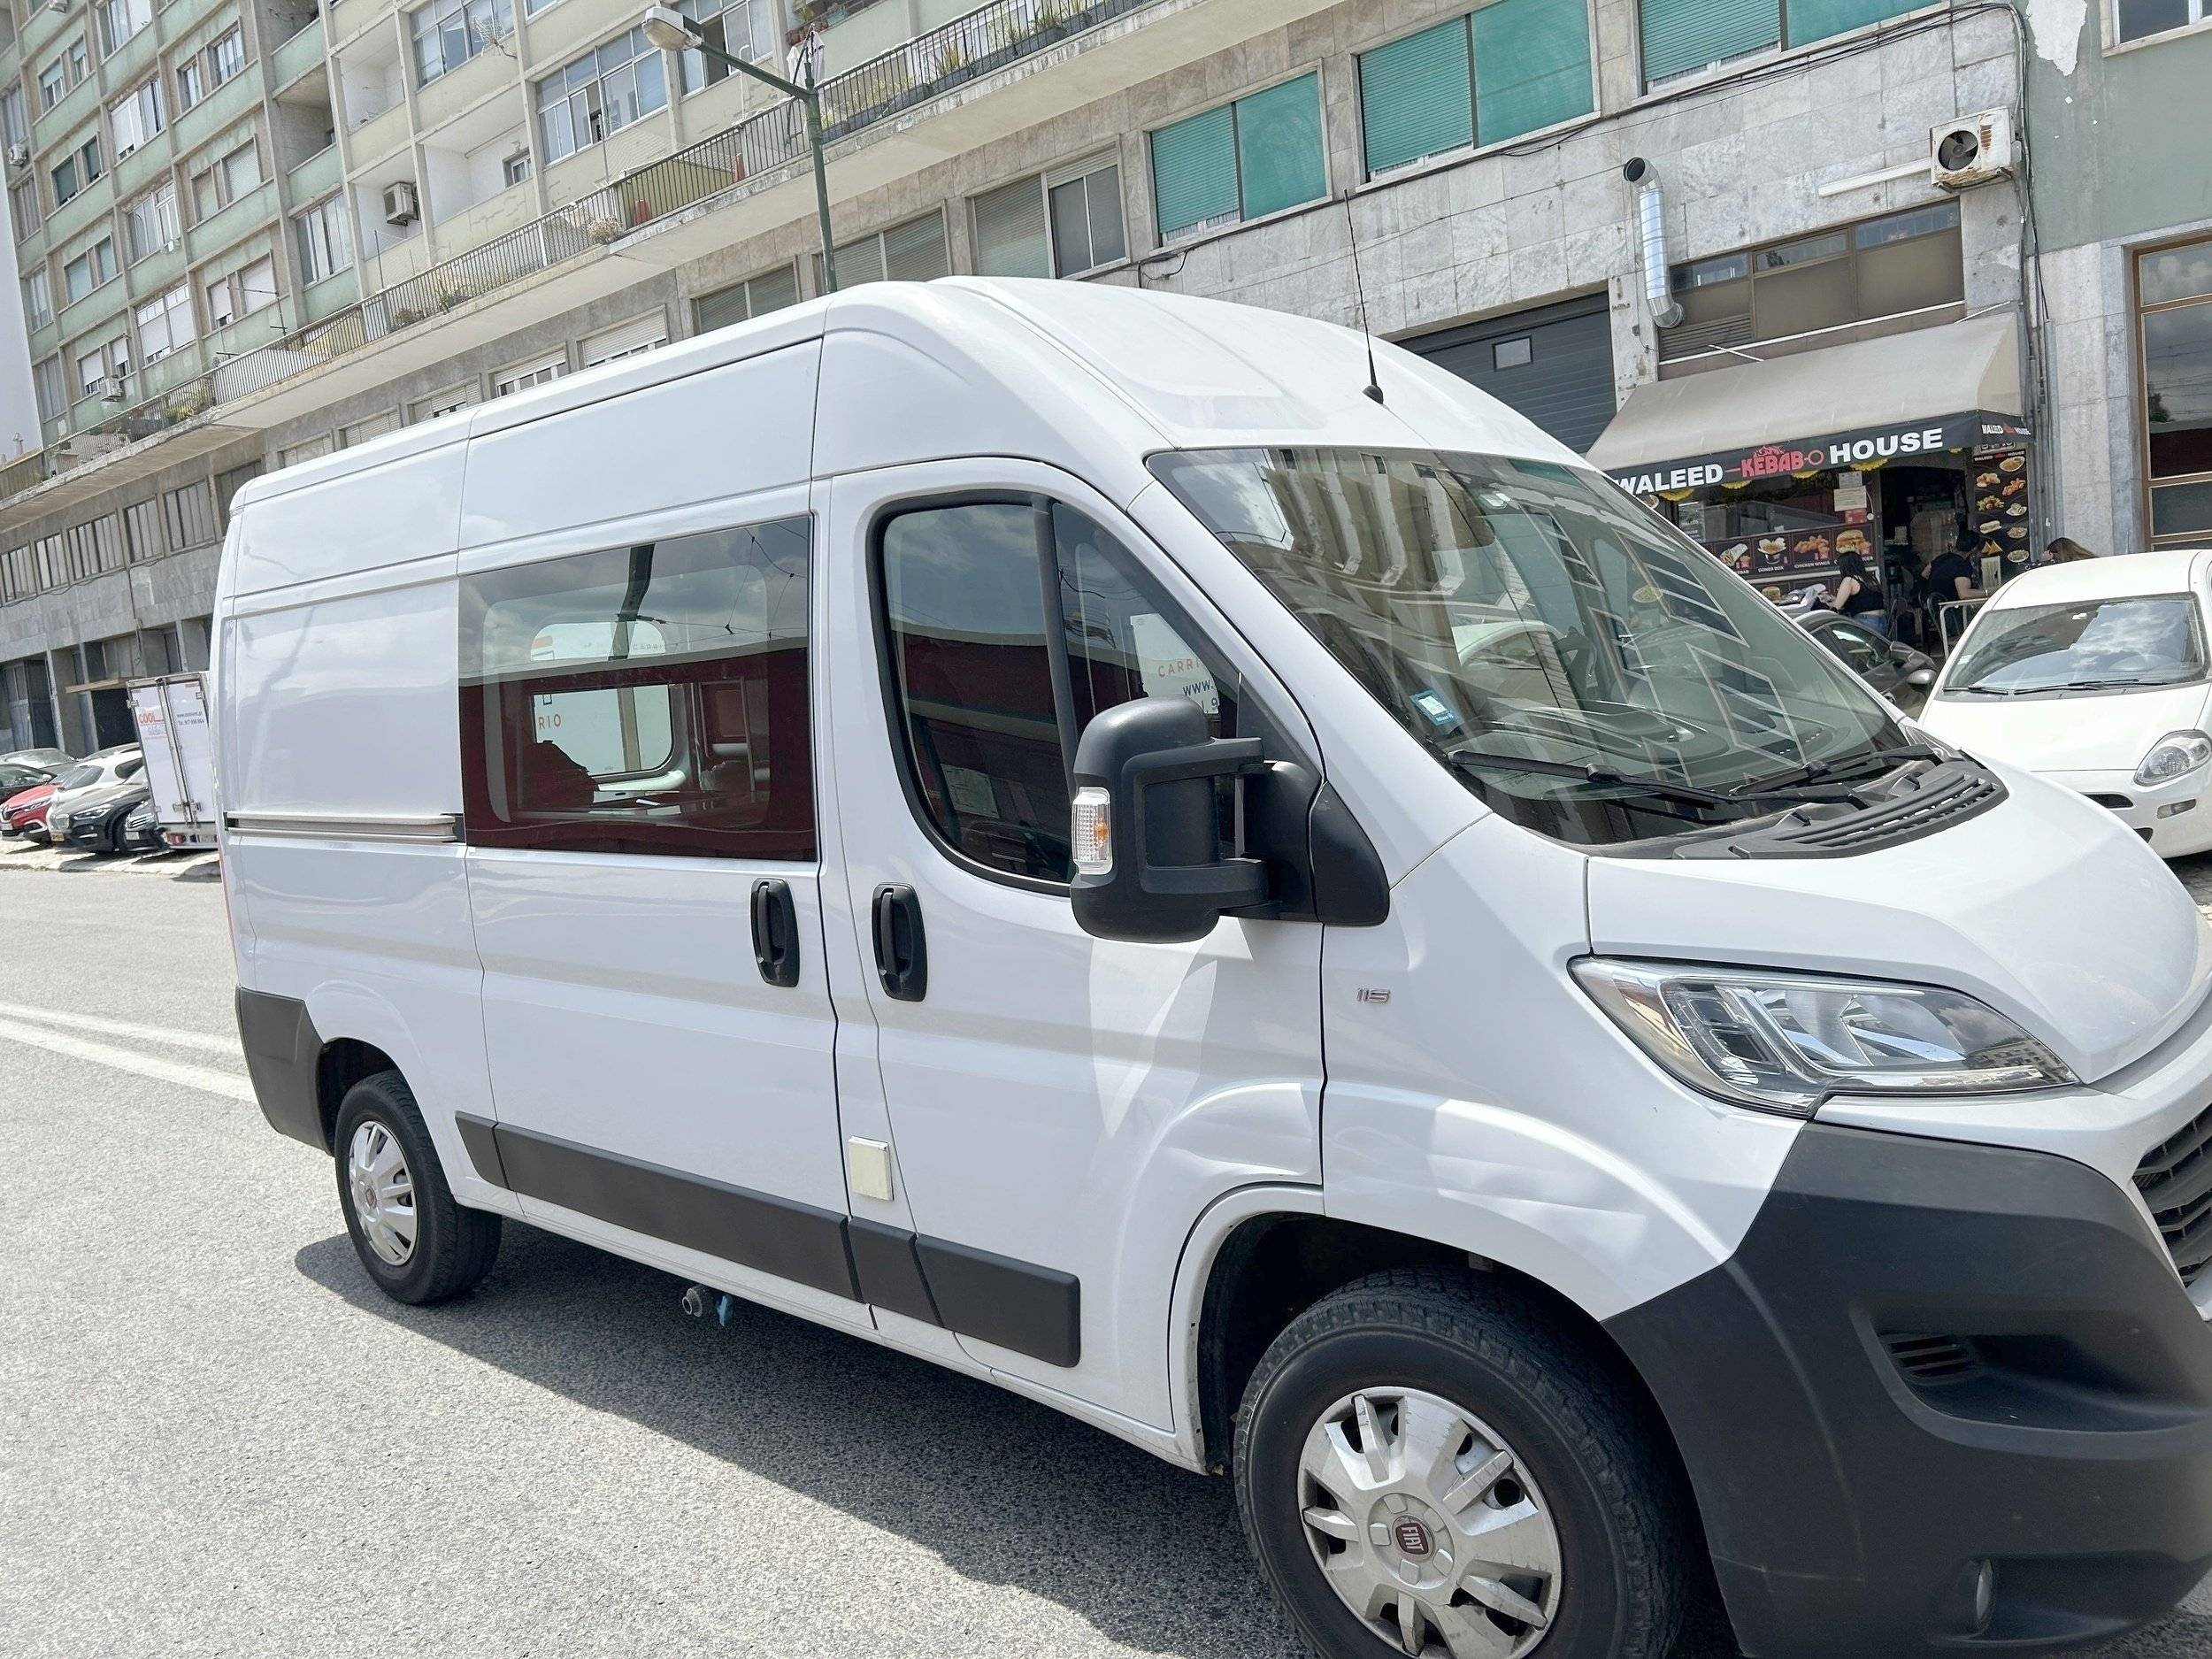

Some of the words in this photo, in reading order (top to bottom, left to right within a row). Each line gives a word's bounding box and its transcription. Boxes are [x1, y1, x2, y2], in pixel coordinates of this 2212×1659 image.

[1615, 463, 1724, 495] WALEED
[1740, 450, 1805, 478] KEBAB
[1829, 427, 1944, 465] HOUSE
[1401, 1525, 1425, 1552] FIAT
